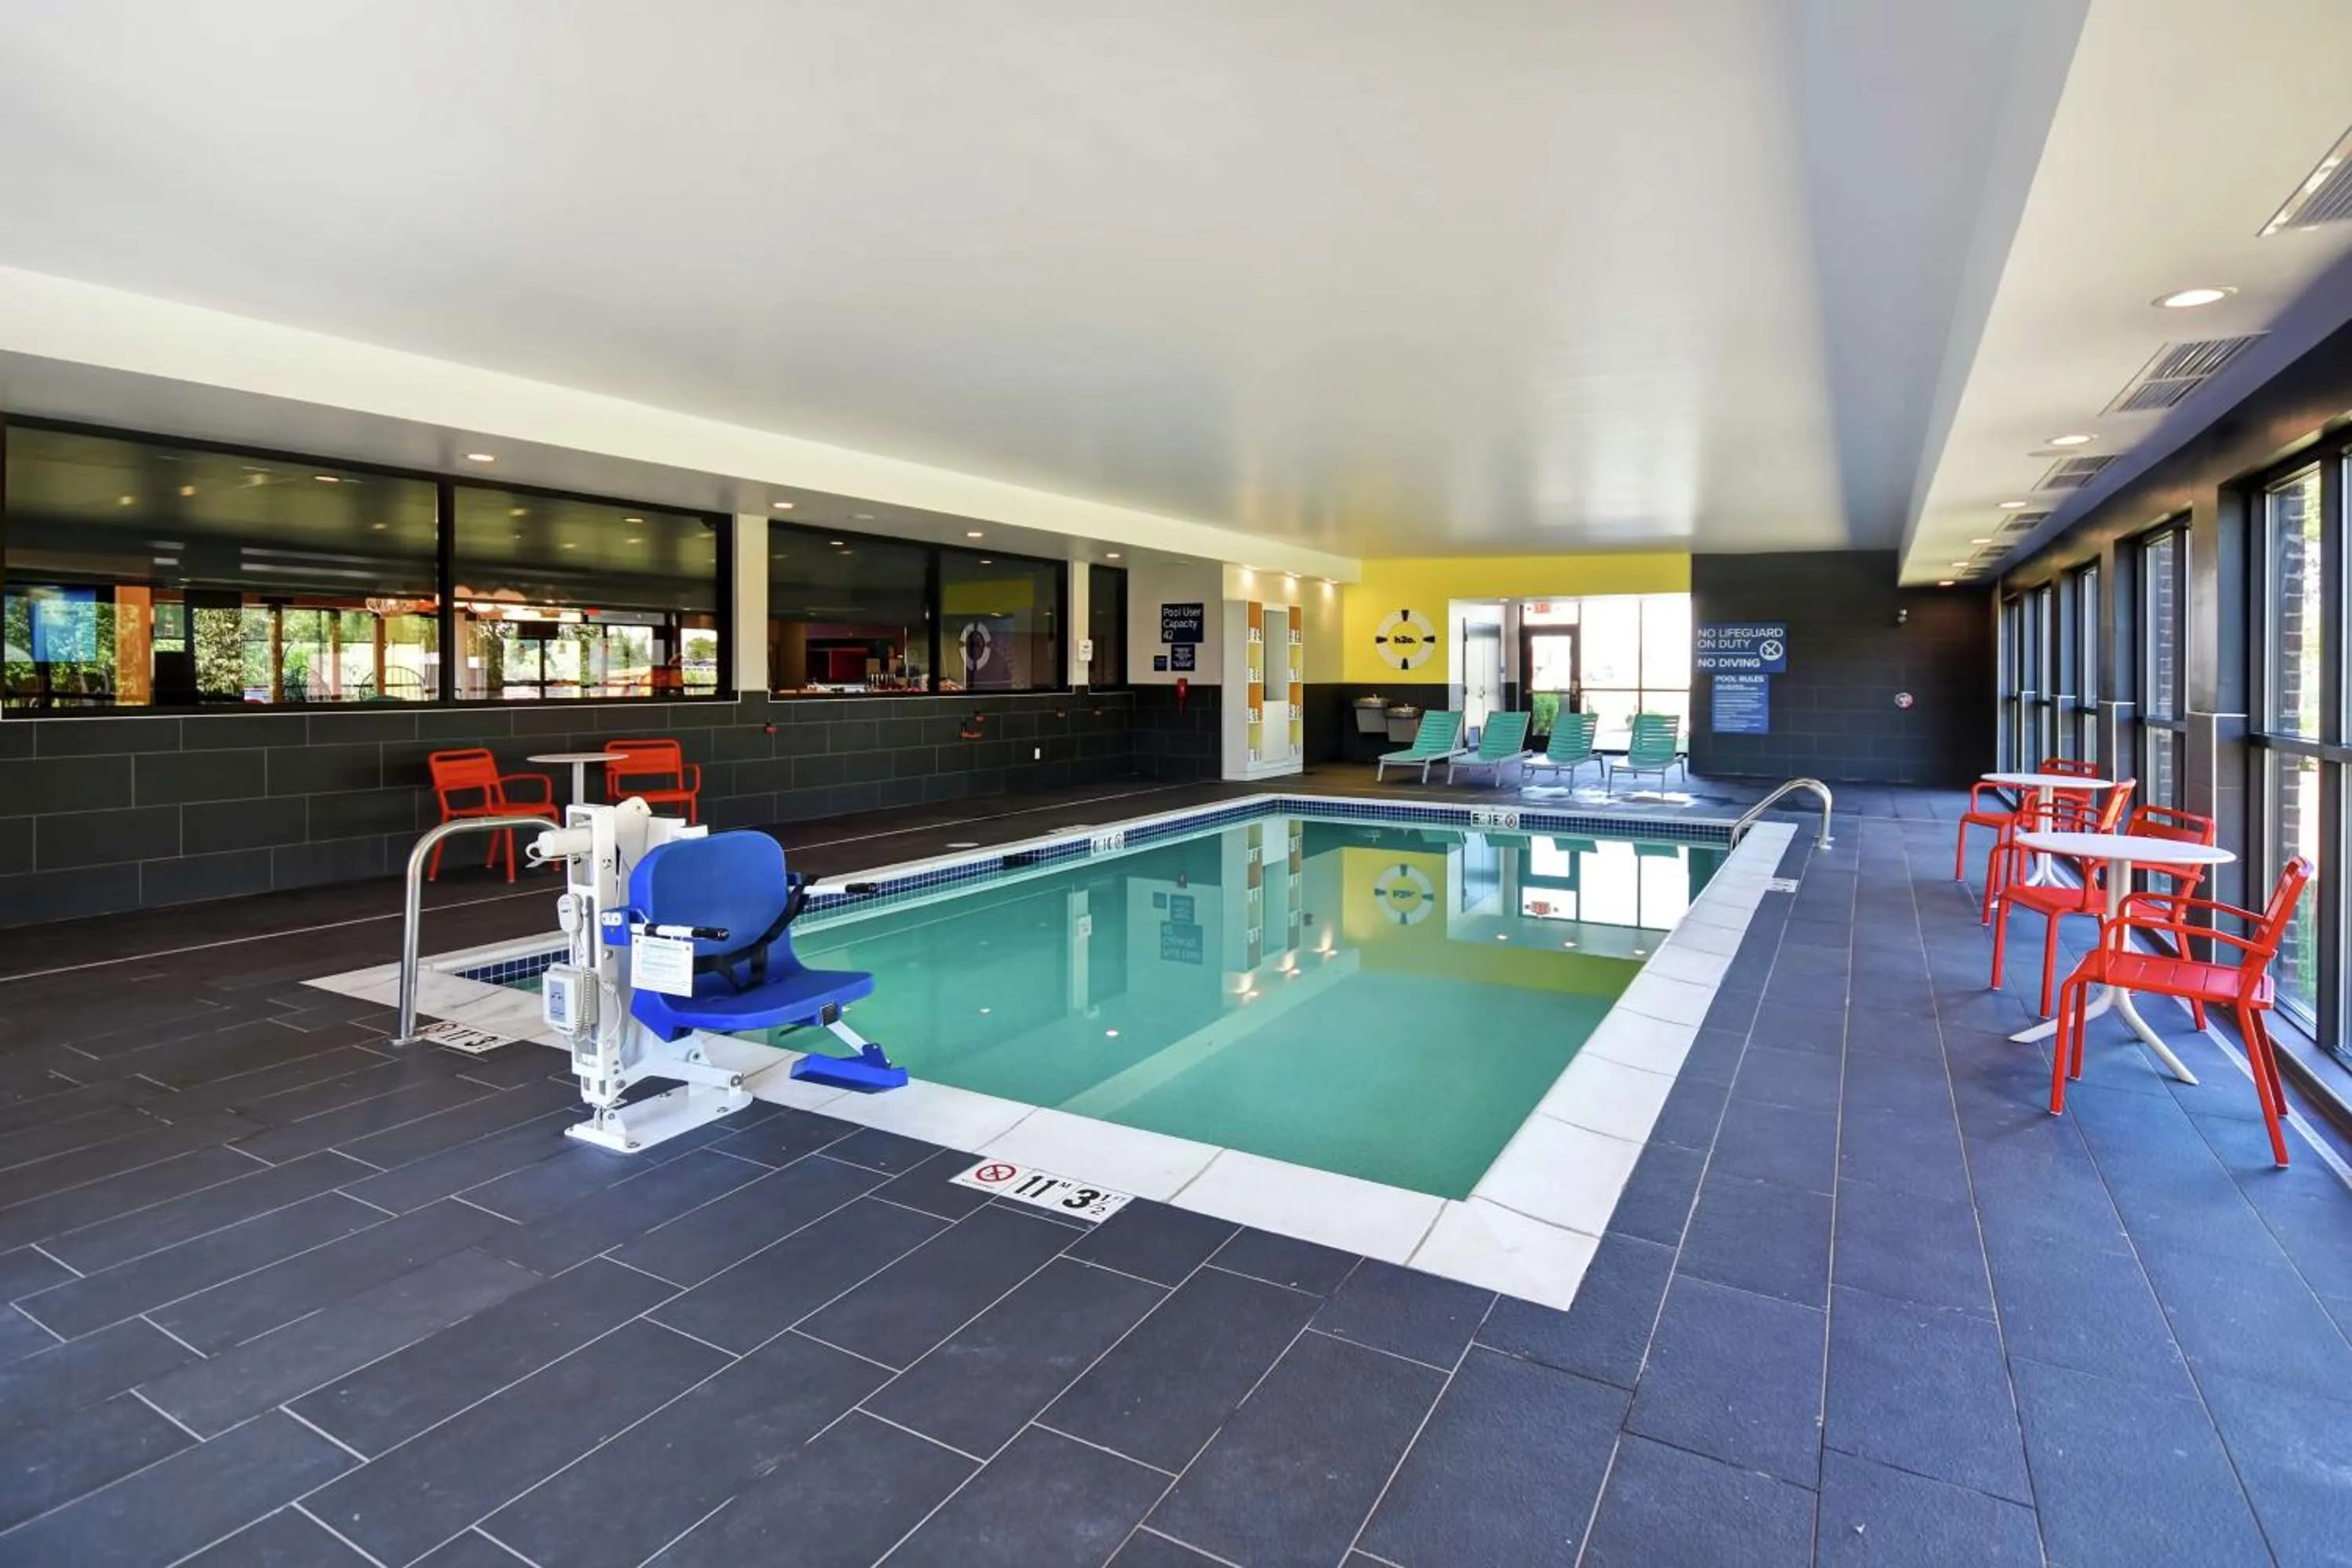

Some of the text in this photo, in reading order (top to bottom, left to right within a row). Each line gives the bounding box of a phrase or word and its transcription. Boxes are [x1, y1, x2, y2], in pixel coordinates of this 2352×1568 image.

[1163, 607, 1201, 617] Pool User
[1163, 619, 1198, 631] Capacity
[1697, 628, 1784, 638] NO LIFEGUARD
[1697, 639, 1751, 649] ON DUTY
[1697, 658, 1761, 667] NO DIVING
